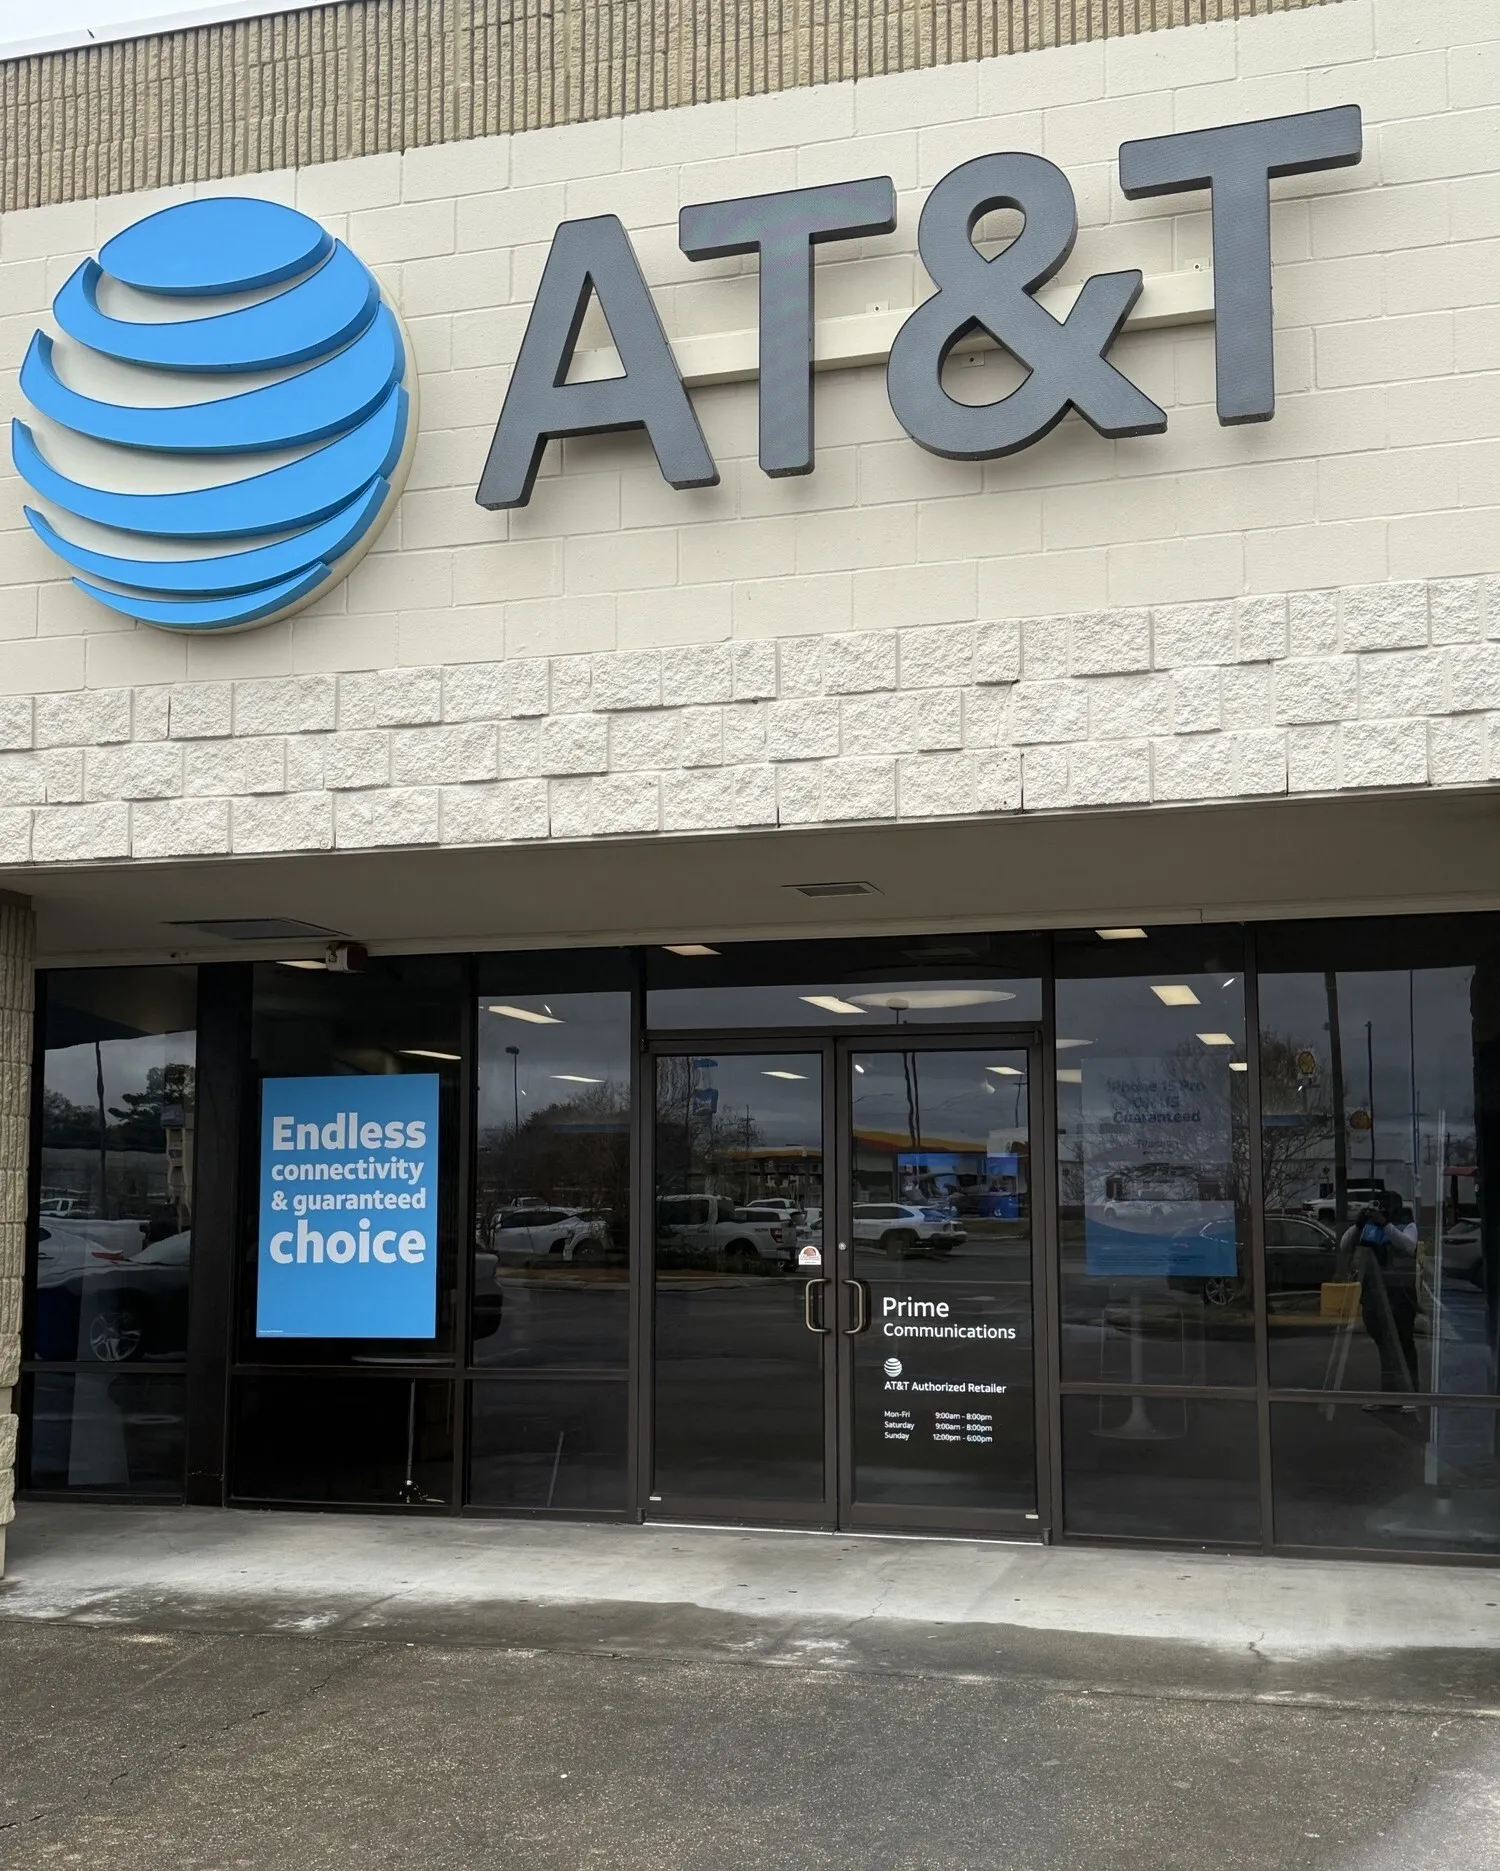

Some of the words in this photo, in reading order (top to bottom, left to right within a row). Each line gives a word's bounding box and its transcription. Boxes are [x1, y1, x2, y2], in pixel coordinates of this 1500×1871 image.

[476, 104, 1362, 510] AT&T
[1113, 1109, 1201, 1124] Guaranteed
[272, 1112, 427, 1151] Endless
[271, 1156, 425, 1185] connectivity
[271, 1190, 288, 1211] &
[292, 1187, 427, 1216] guaranteed
[269, 1217, 427, 1264] choice
[882, 1296, 950, 1318] Prime
[883, 1323, 1016, 1339] Communications
[884, 1381, 909, 1391] AT&T
[911, 1381, 966, 1393] Authorized
[968, 1383, 1007, 1394] Retailer
[884, 1410, 911, 1418] Mon-Fri
[935, 1411, 960, 1420] 9:00am
[966, 1412, 992, 1422] 8:00pm
[884, 1421, 915, 1431] Saturday
[935, 1422, 960, 1431] 9:00am
[966, 1423, 992, 1433] 8:00pm
[884, 1431, 910, 1441] Sunday
[932, 1433, 961, 1442] 12:00pm
[966, 1434, 992, 1443] 6:00pm
